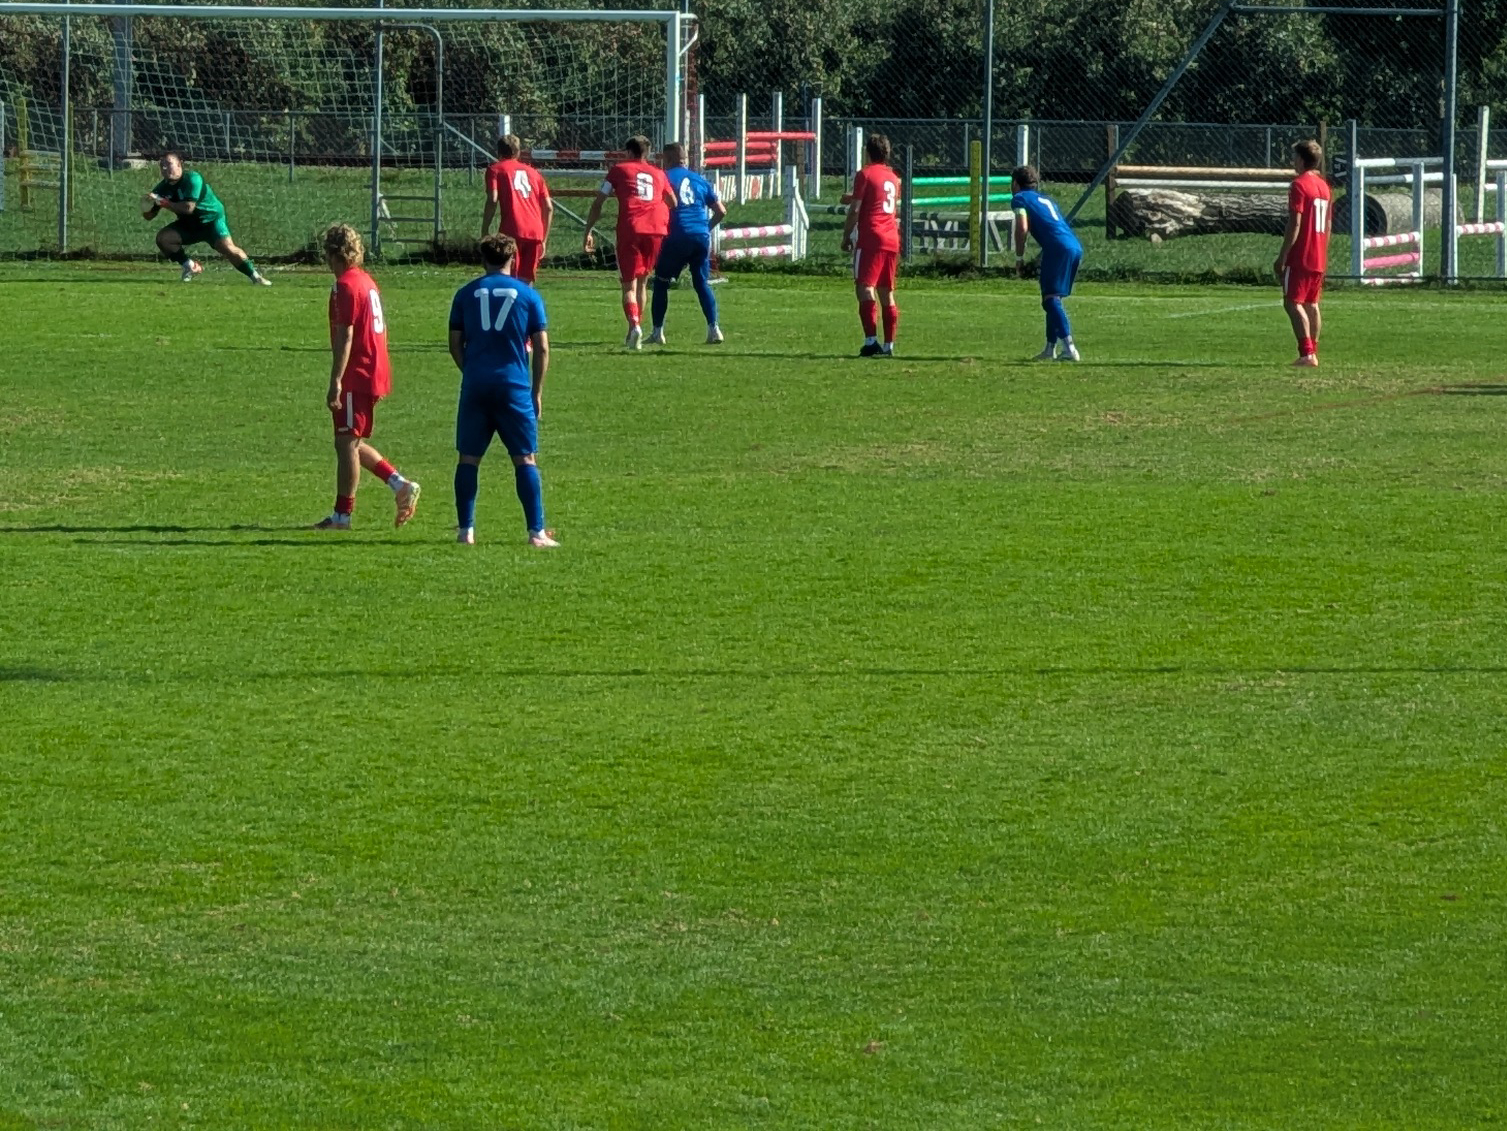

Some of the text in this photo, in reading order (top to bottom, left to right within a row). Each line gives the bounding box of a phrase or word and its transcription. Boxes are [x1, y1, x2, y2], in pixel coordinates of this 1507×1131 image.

[513, 169, 532, 199] 4
[679, 177, 695, 205] 6
[882, 180, 896, 214] 3
[1313, 197, 1329, 234] 11
[369, 288, 384, 334] 9
[473, 287, 518, 331] 17
